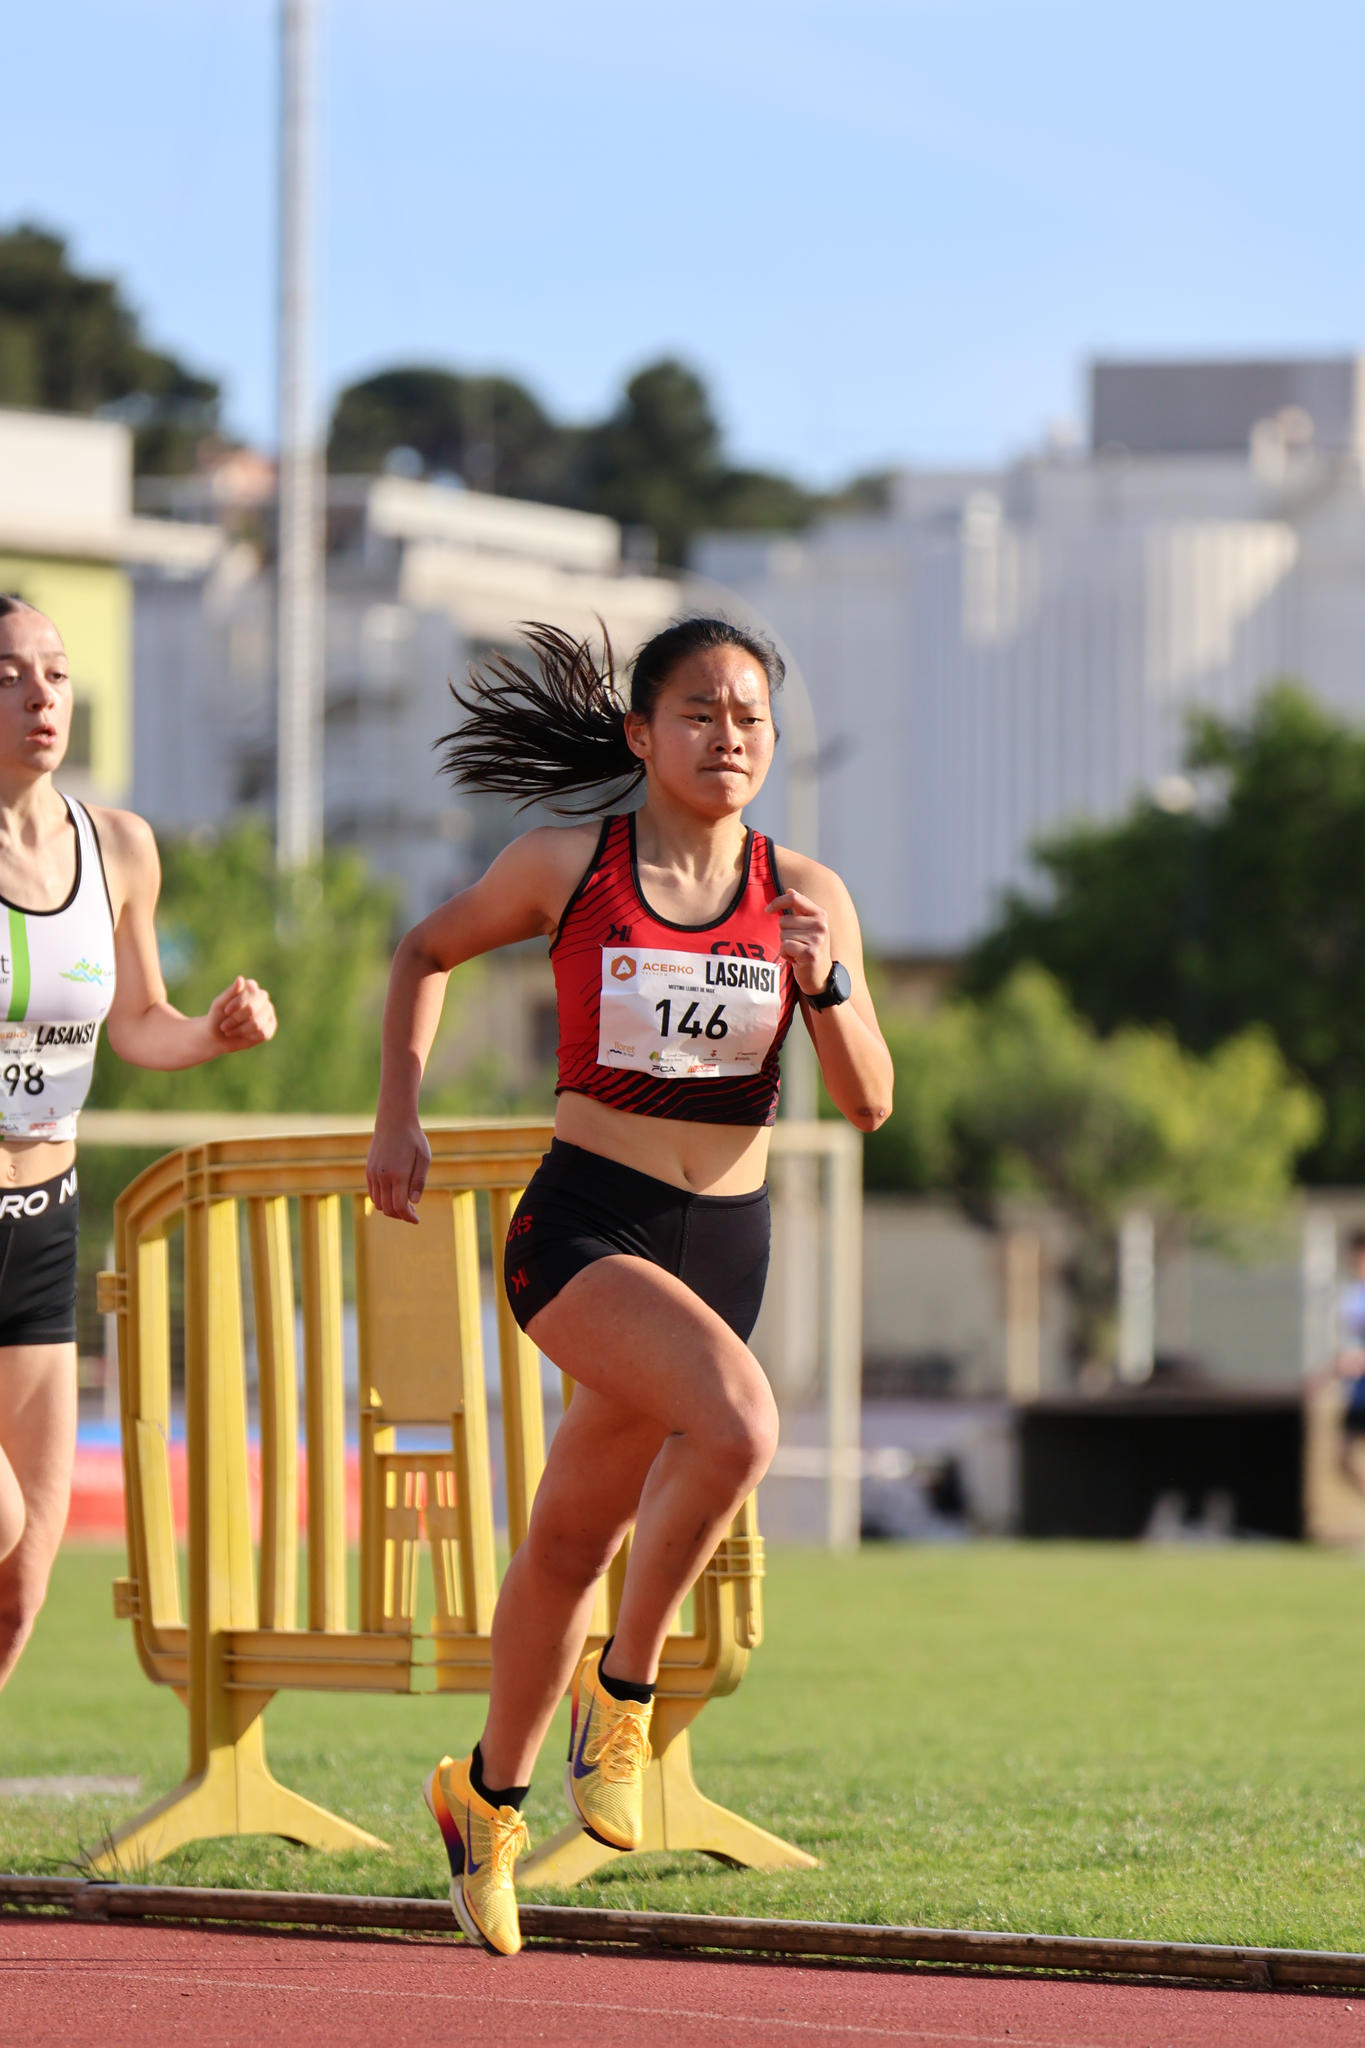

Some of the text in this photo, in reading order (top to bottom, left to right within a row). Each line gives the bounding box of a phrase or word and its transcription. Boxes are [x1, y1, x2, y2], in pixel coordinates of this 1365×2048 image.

[642, 962, 694, 975] ACERKO
[705, 961, 775, 993] LASANSI
[655, 998, 729, 1040] 146
[36, 1022, 96, 1046] LASANSI
